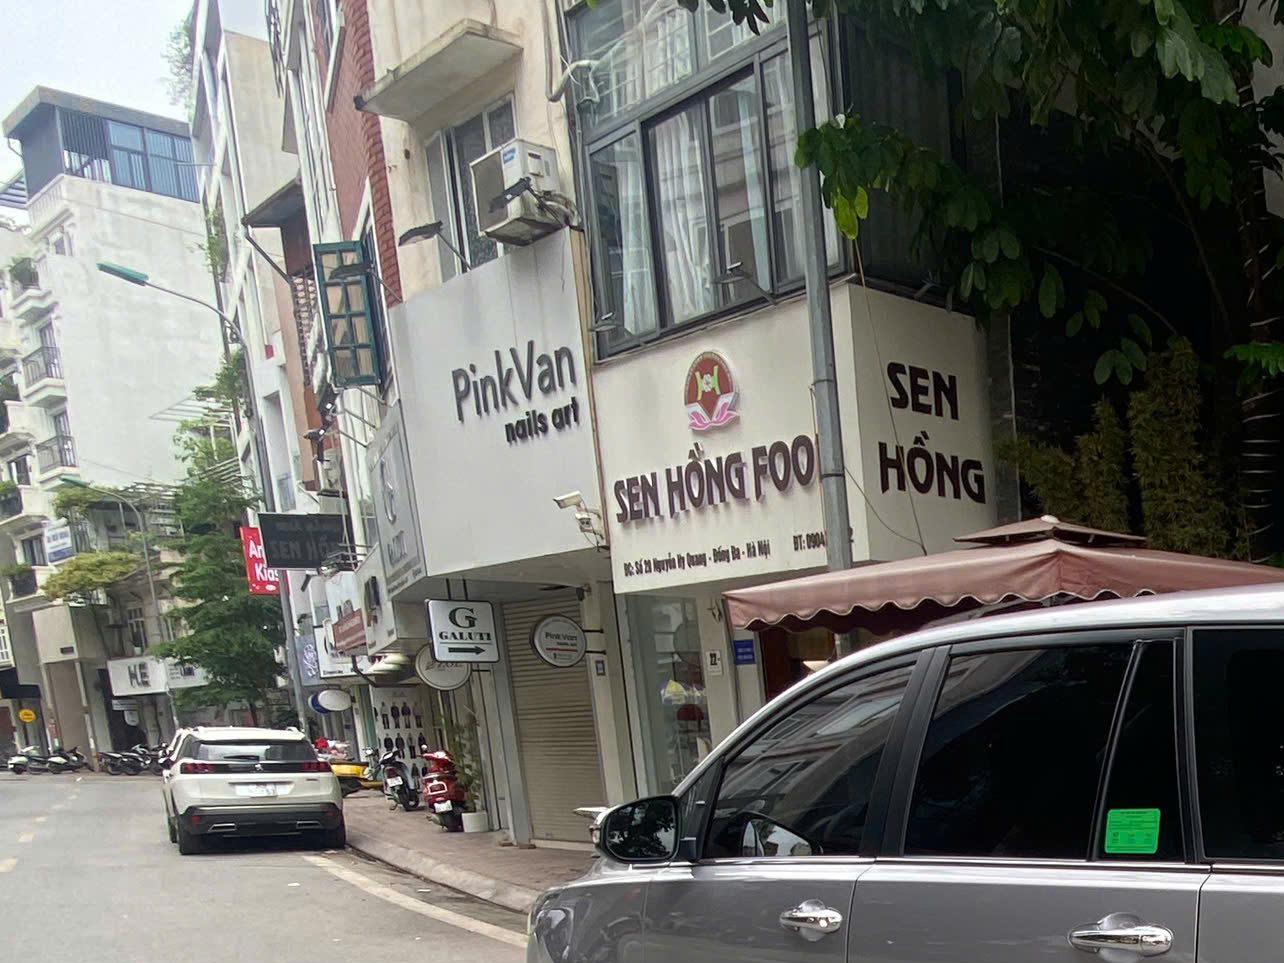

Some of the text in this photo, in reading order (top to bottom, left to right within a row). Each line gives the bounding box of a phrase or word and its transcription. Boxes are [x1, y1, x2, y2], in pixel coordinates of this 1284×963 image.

[886, 362, 959, 421] SEN
[505, 396, 579, 445] nails art
[614, 434, 821, 524] SEN HỒNG FOO
[878, 431, 986, 504] HỒNG
[439, 631, 492, 641] GALUTI
[449, 607, 477, 629] G
